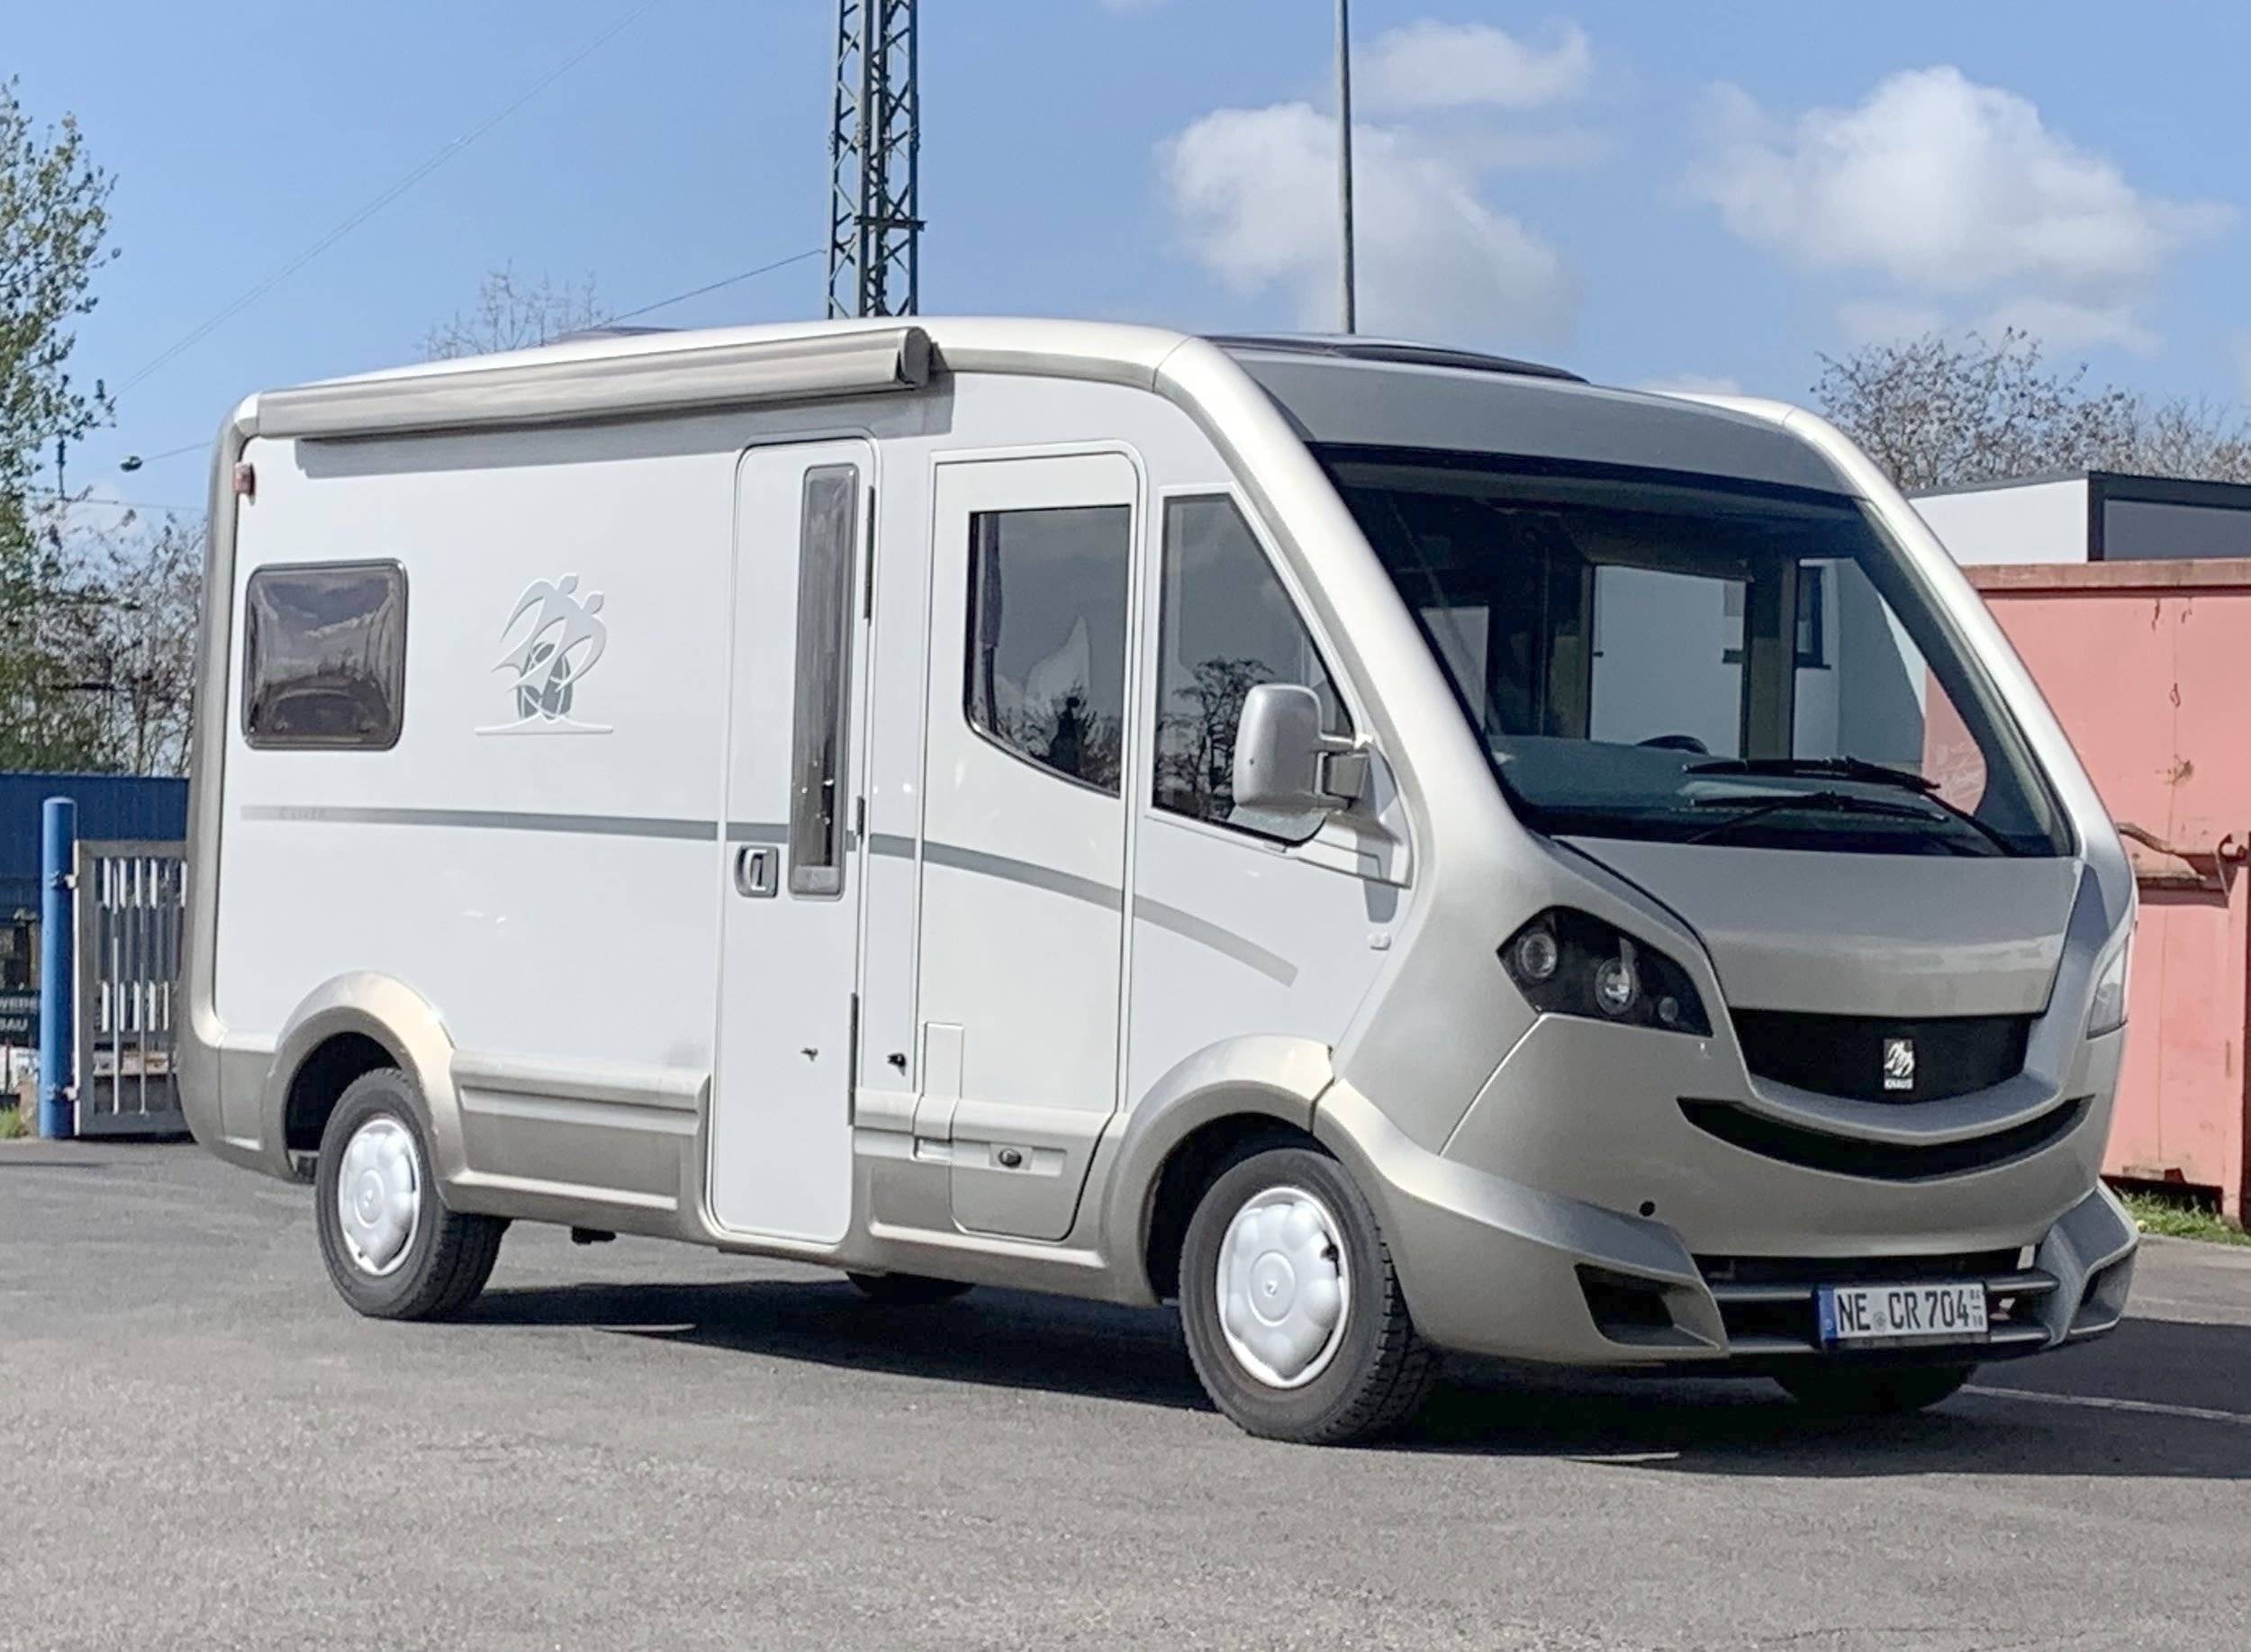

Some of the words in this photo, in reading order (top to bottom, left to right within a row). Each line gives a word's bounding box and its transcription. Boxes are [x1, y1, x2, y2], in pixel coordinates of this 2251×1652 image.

[1837, 1293, 1871, 1332] NE
[1888, 1291, 1921, 1330] CR
[1925, 1289, 1969, 1328] 704
